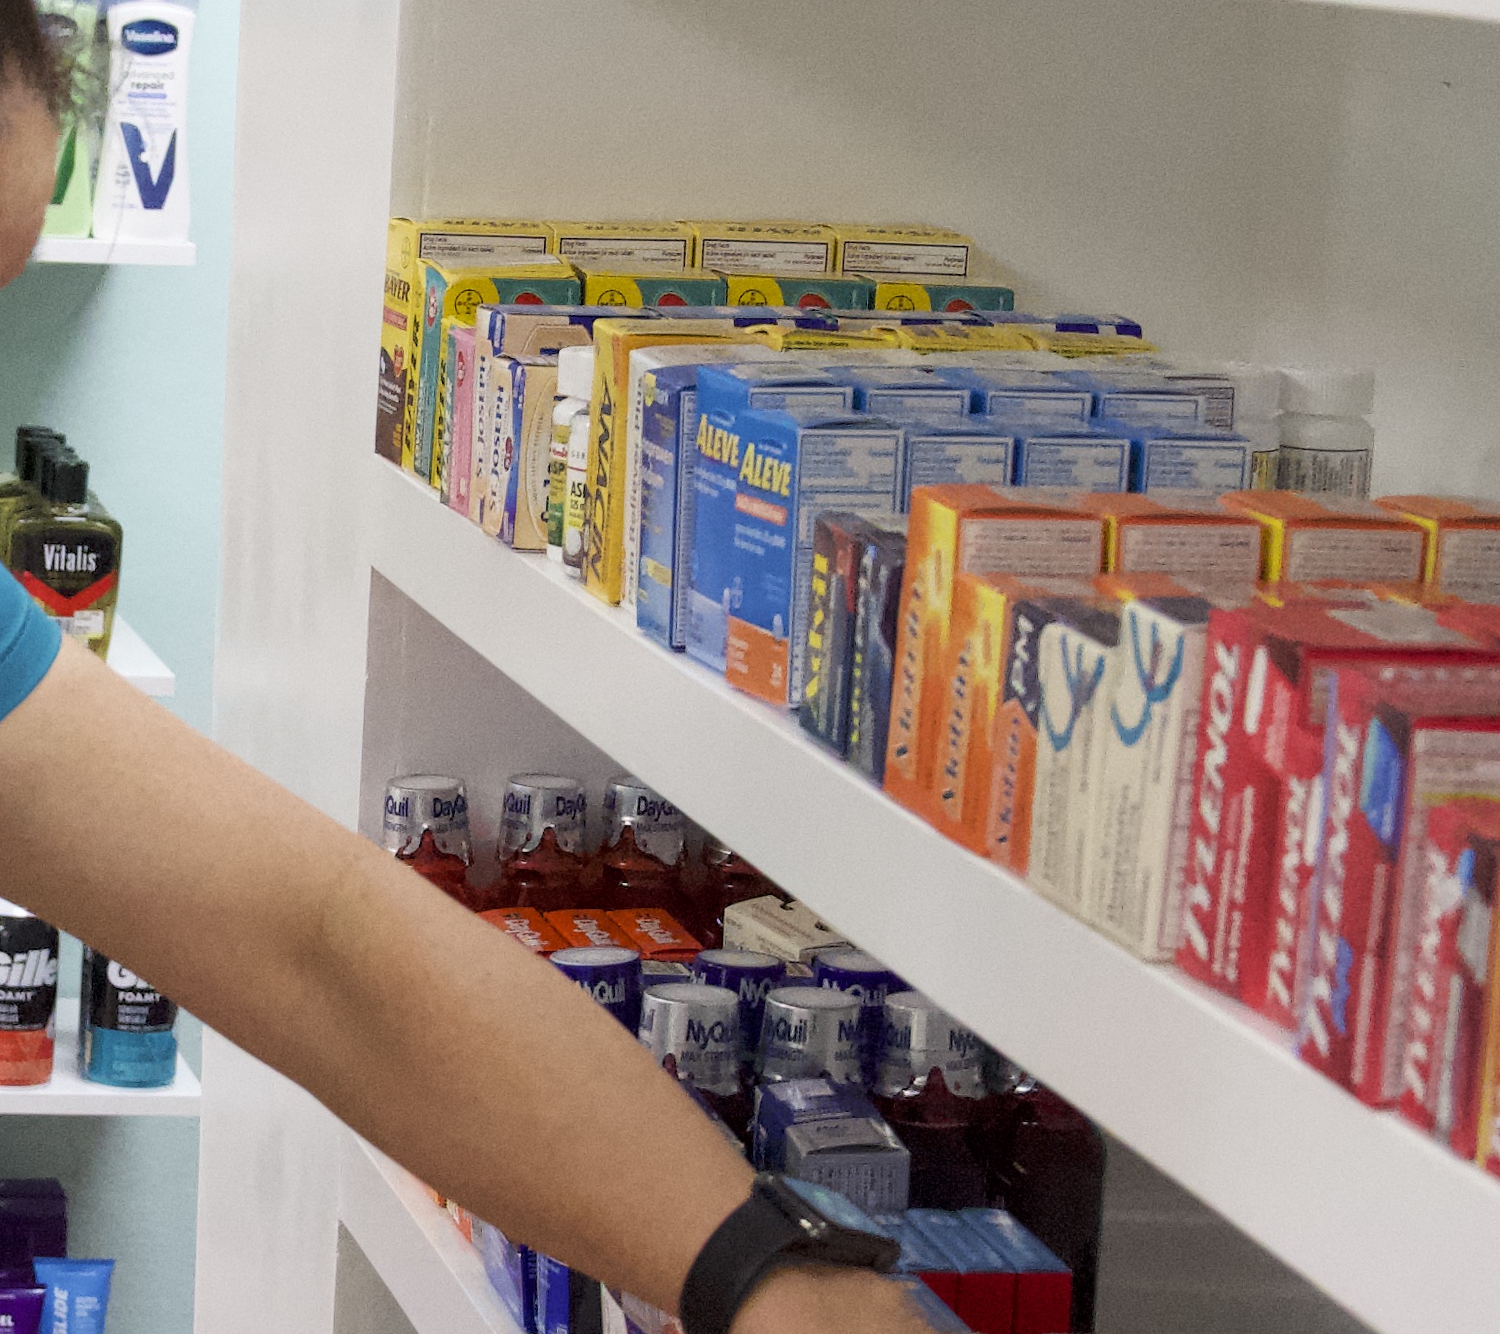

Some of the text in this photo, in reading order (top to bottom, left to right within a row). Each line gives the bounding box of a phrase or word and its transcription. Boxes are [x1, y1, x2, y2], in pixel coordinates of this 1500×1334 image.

[697, 412, 740, 467] ALEVE
[590, 373, 615, 581] ANACIN
[739, 442, 792, 497] ALEVE
[43, 545, 98, 572] Vitalis
[1186, 641, 1240, 961] TYLENOL
